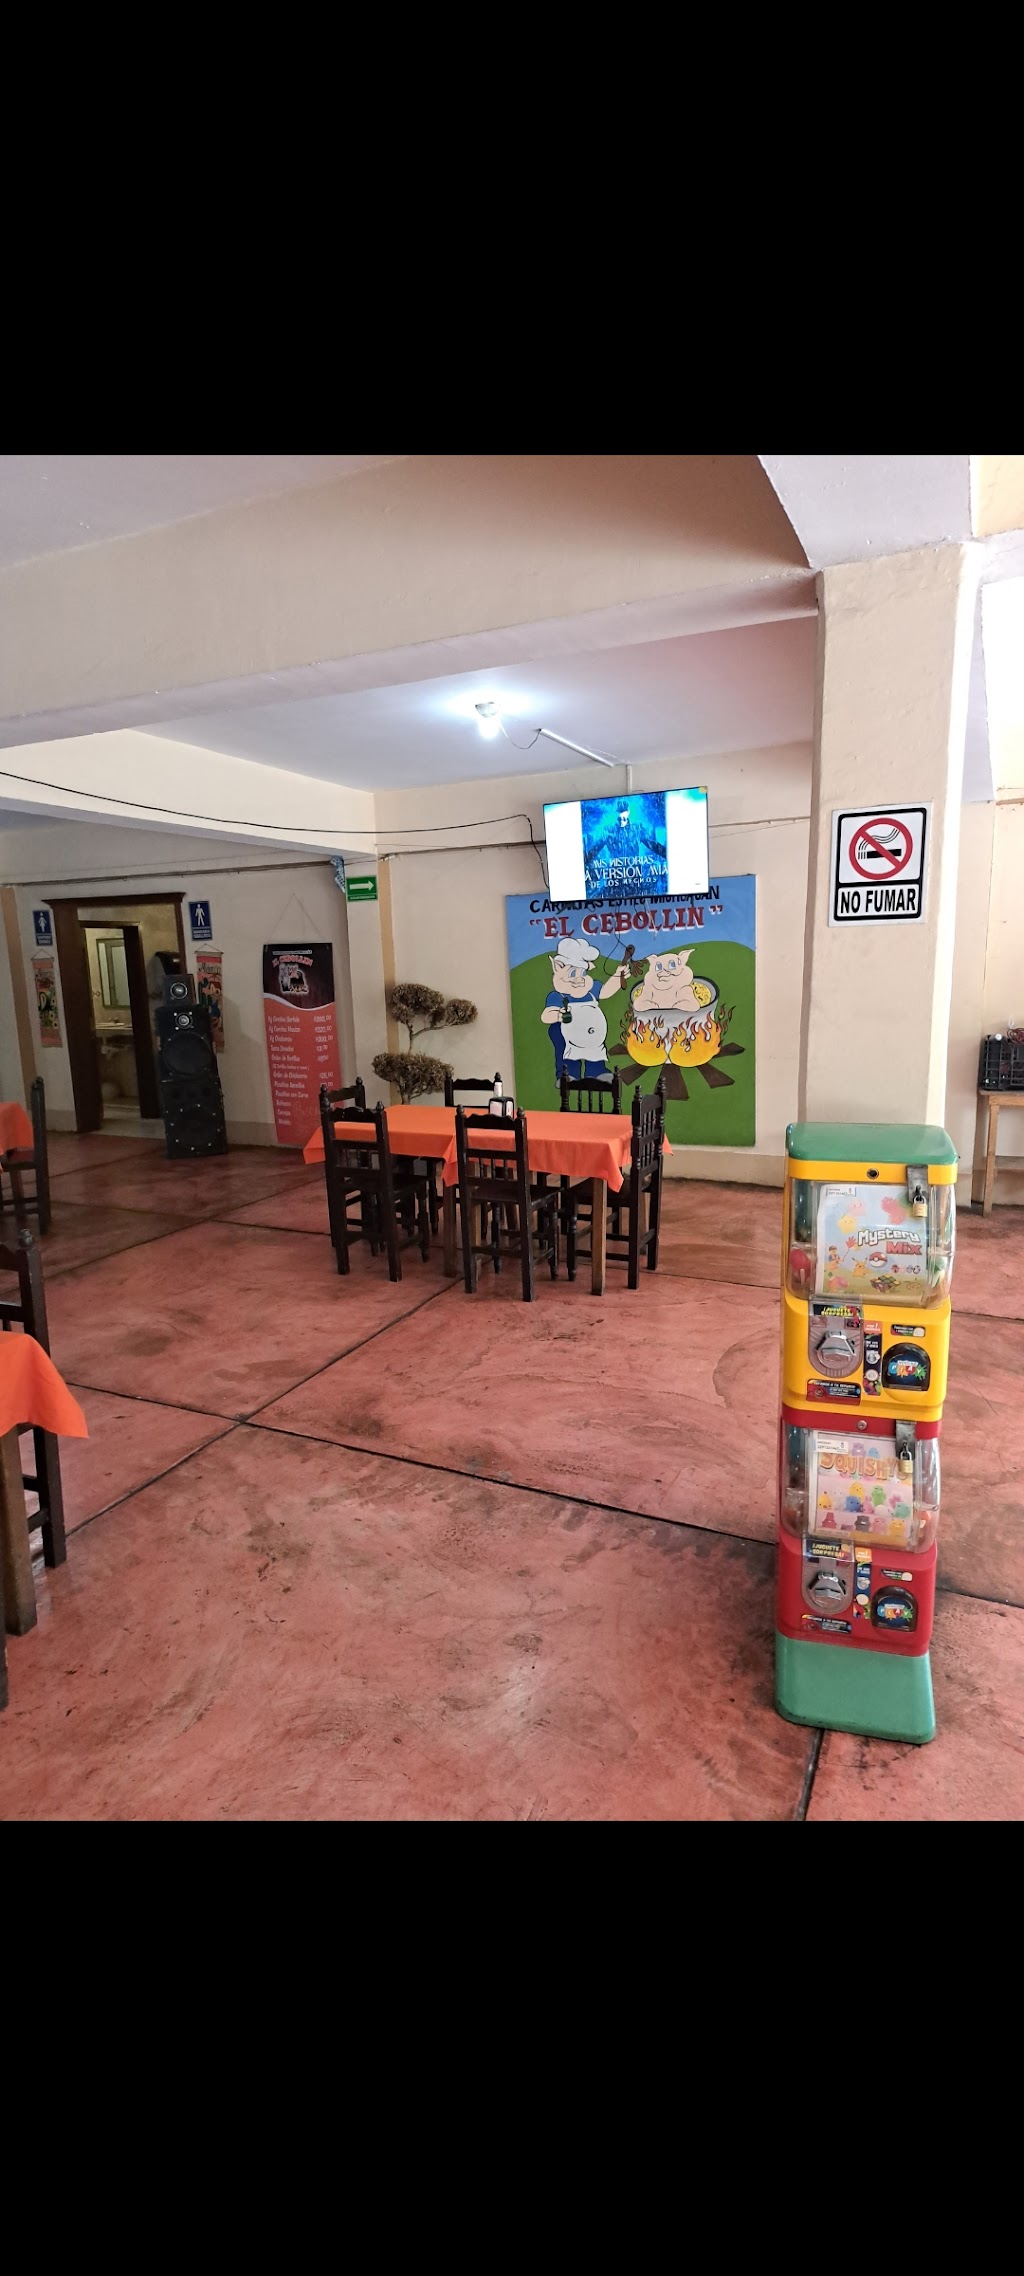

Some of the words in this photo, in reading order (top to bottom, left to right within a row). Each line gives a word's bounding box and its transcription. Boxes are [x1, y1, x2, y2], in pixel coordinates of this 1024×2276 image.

[609, 854, 655, 868] HISTORIAS
[594, 865, 643, 880] VERSION
[591, 880, 601, 889] DE
[604, 879, 620, 888] LOS
[841, 890, 861, 913] NO
[865, 888, 916, 913] FUMAR
[858, 1228, 921, 1247] Mystery
[886, 1241, 922, 1255] Mix
